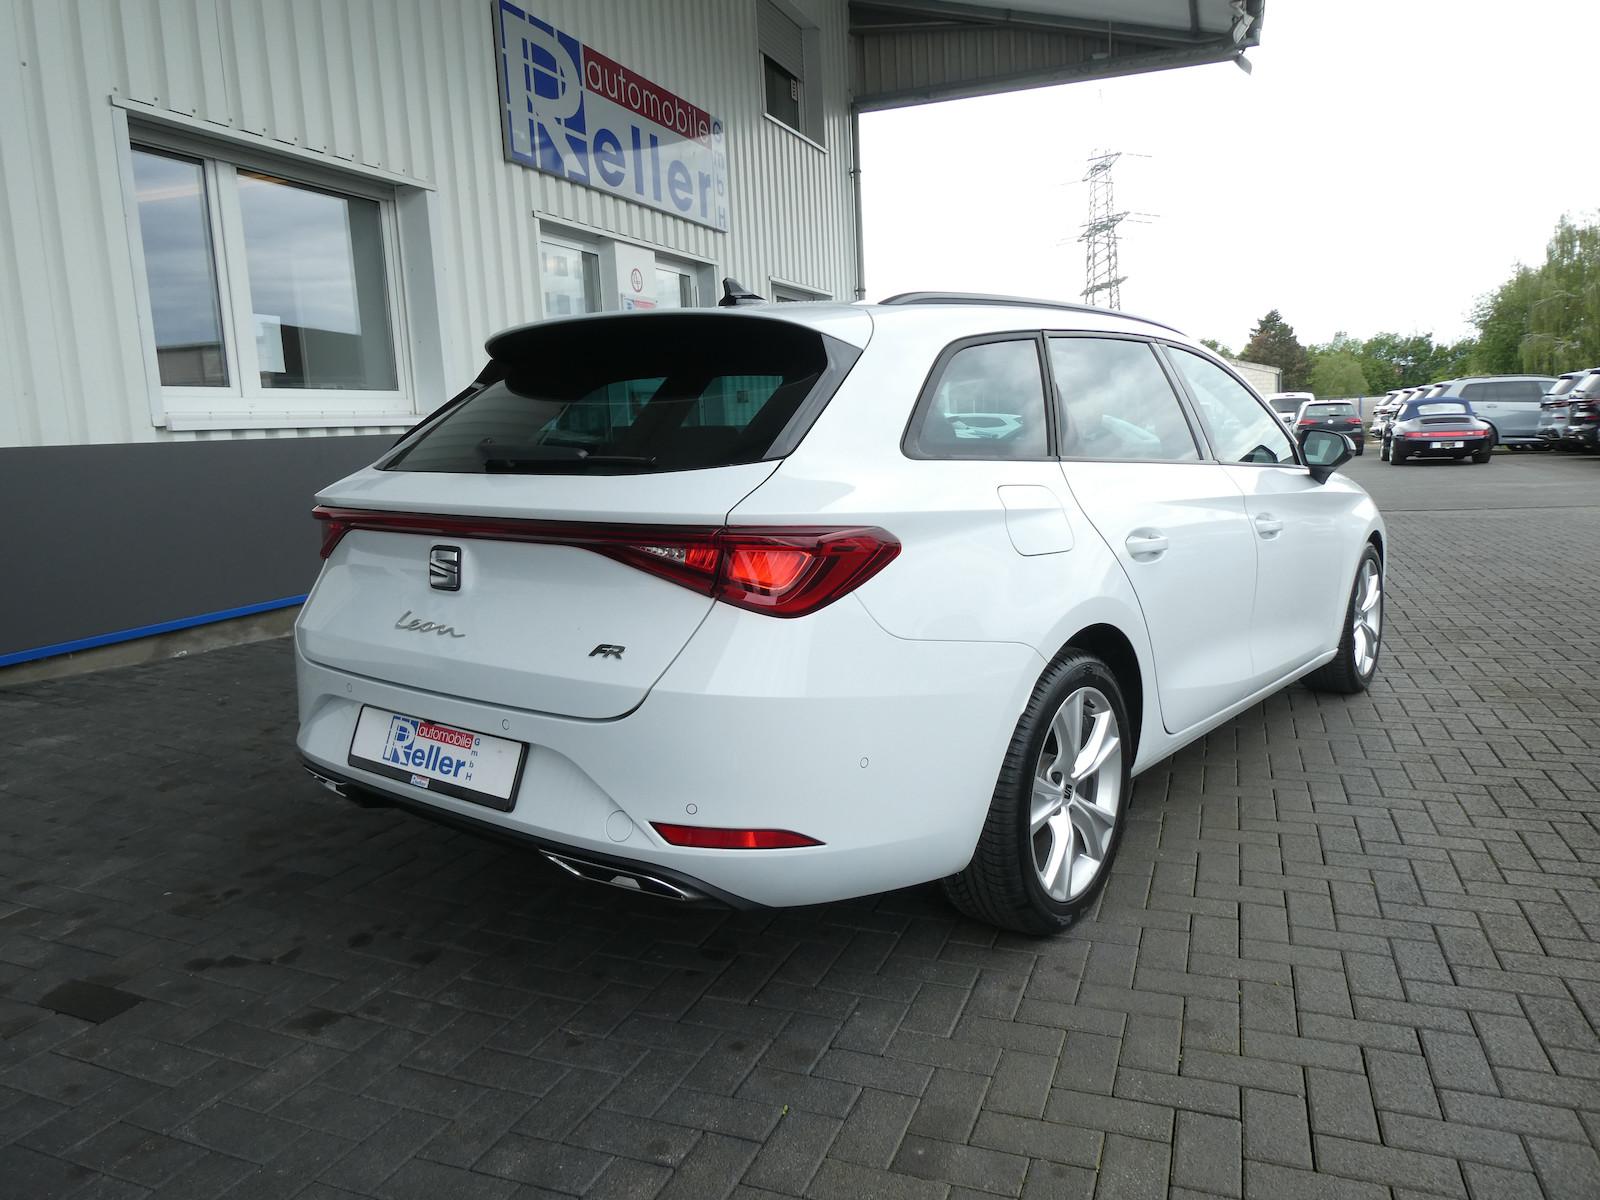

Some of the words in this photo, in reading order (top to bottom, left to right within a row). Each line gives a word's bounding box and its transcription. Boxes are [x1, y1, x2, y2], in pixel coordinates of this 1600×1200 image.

[587, 60, 709, 144] automobile
[394, 610, 466, 639] Leon
[588, 643, 626, 660] FR
[418, 725, 473, 749] automobile
